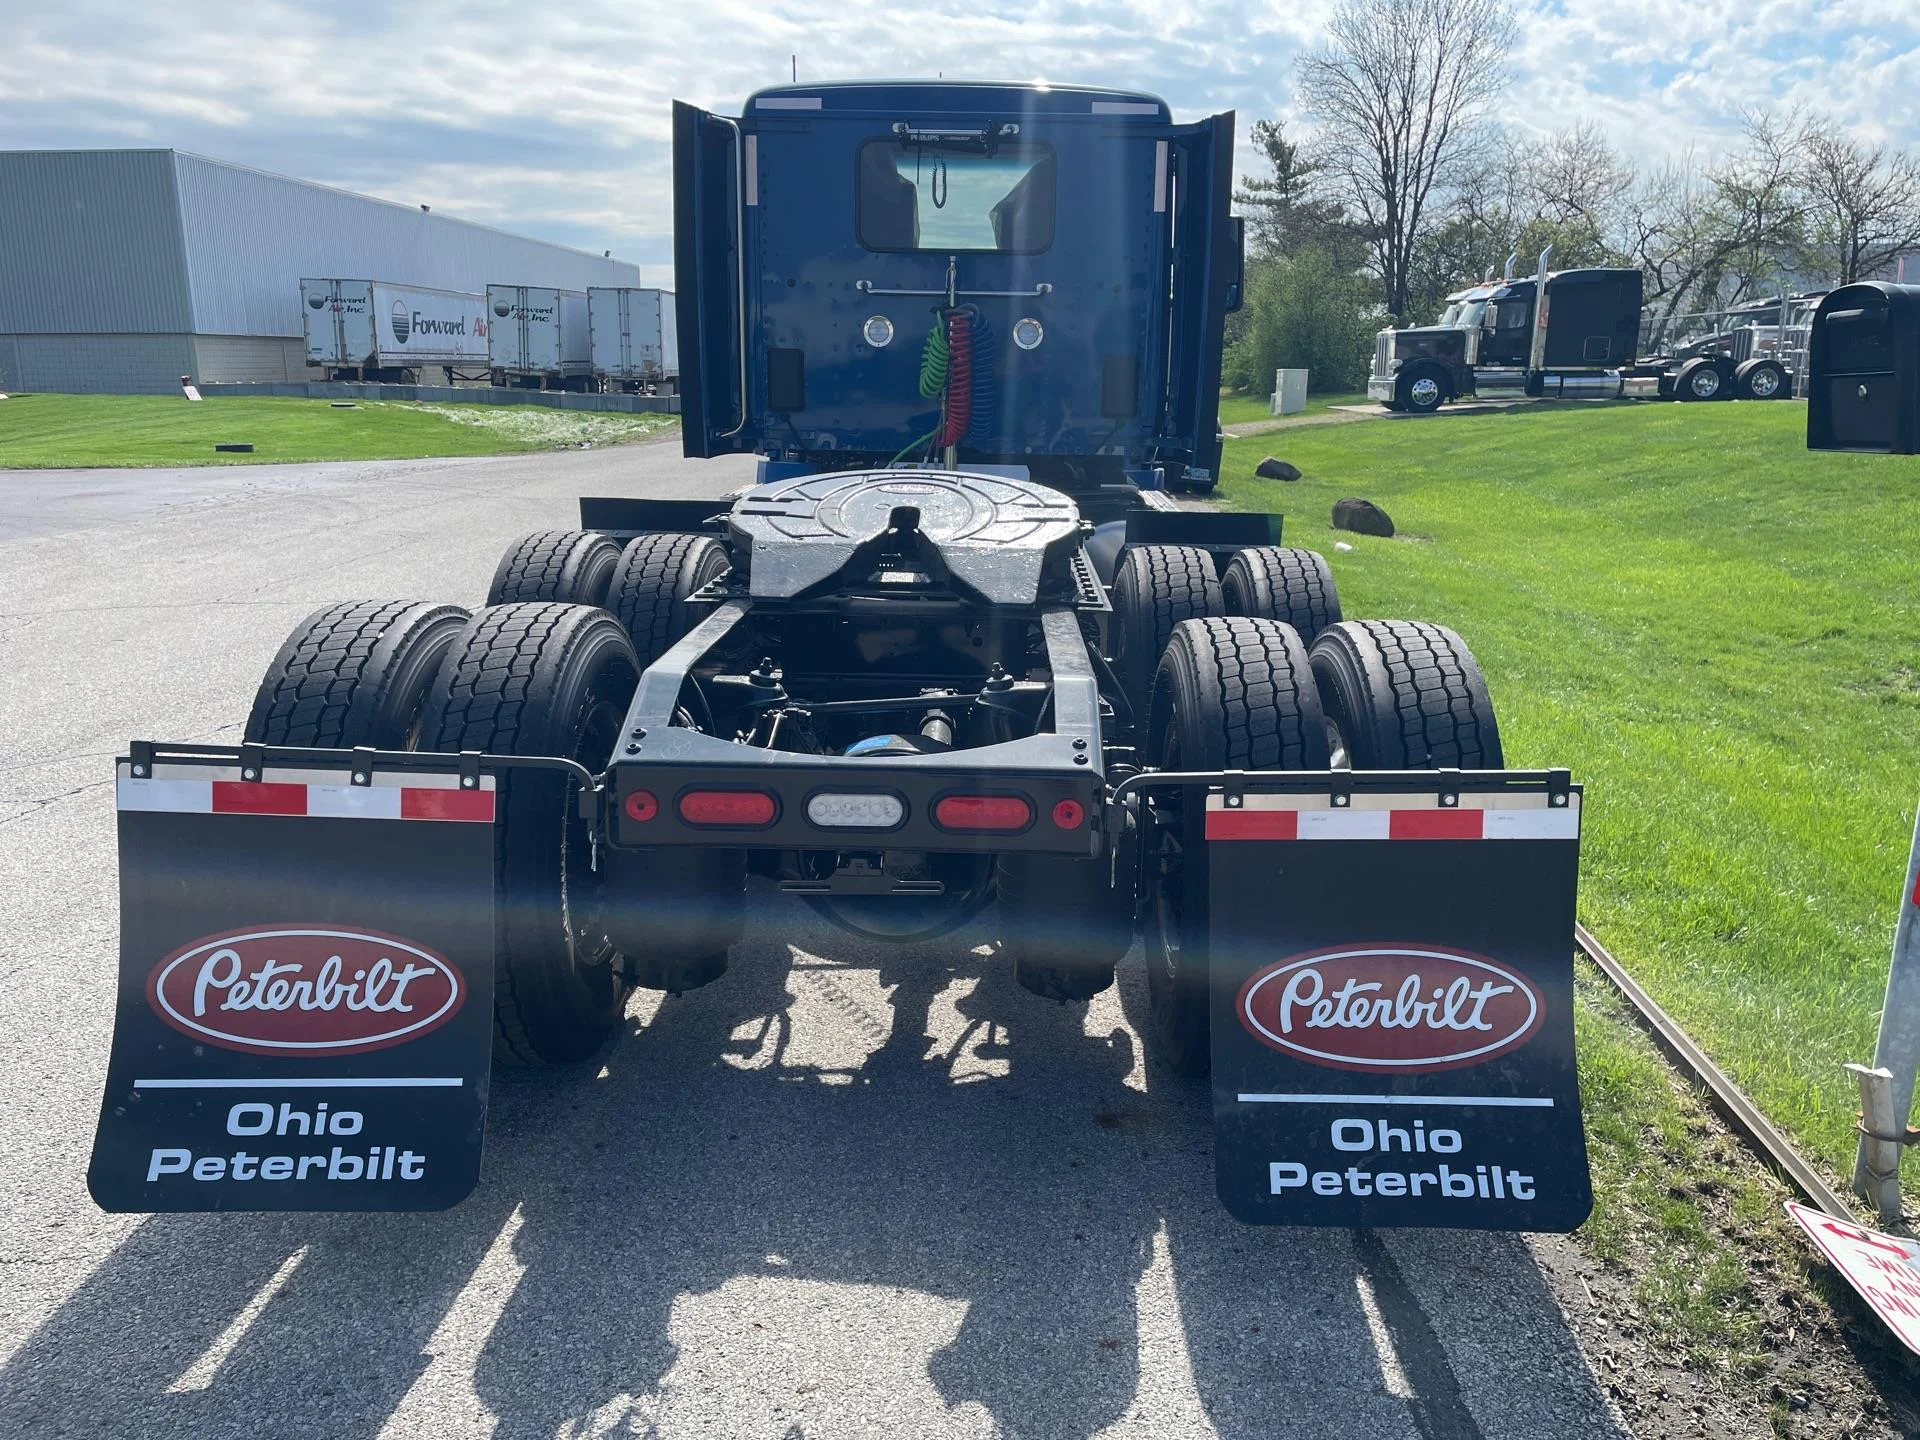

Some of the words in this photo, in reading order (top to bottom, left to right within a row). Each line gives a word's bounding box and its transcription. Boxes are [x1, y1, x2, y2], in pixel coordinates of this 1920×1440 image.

[324, 295, 366, 304] Forward
[511, 304, 553, 314] Forward
[412, 311, 466, 336] Forward
[193, 948, 436, 1017] Peterbilt
[1279, 968, 1514, 1034] Peterbilt
[226, 1102, 364, 1137] Ohio
[1330, 1118, 1463, 1154] Ohio
[146, 1146, 426, 1182] Peterbilt
[1269, 1162, 1536, 1200] Peterbilt
